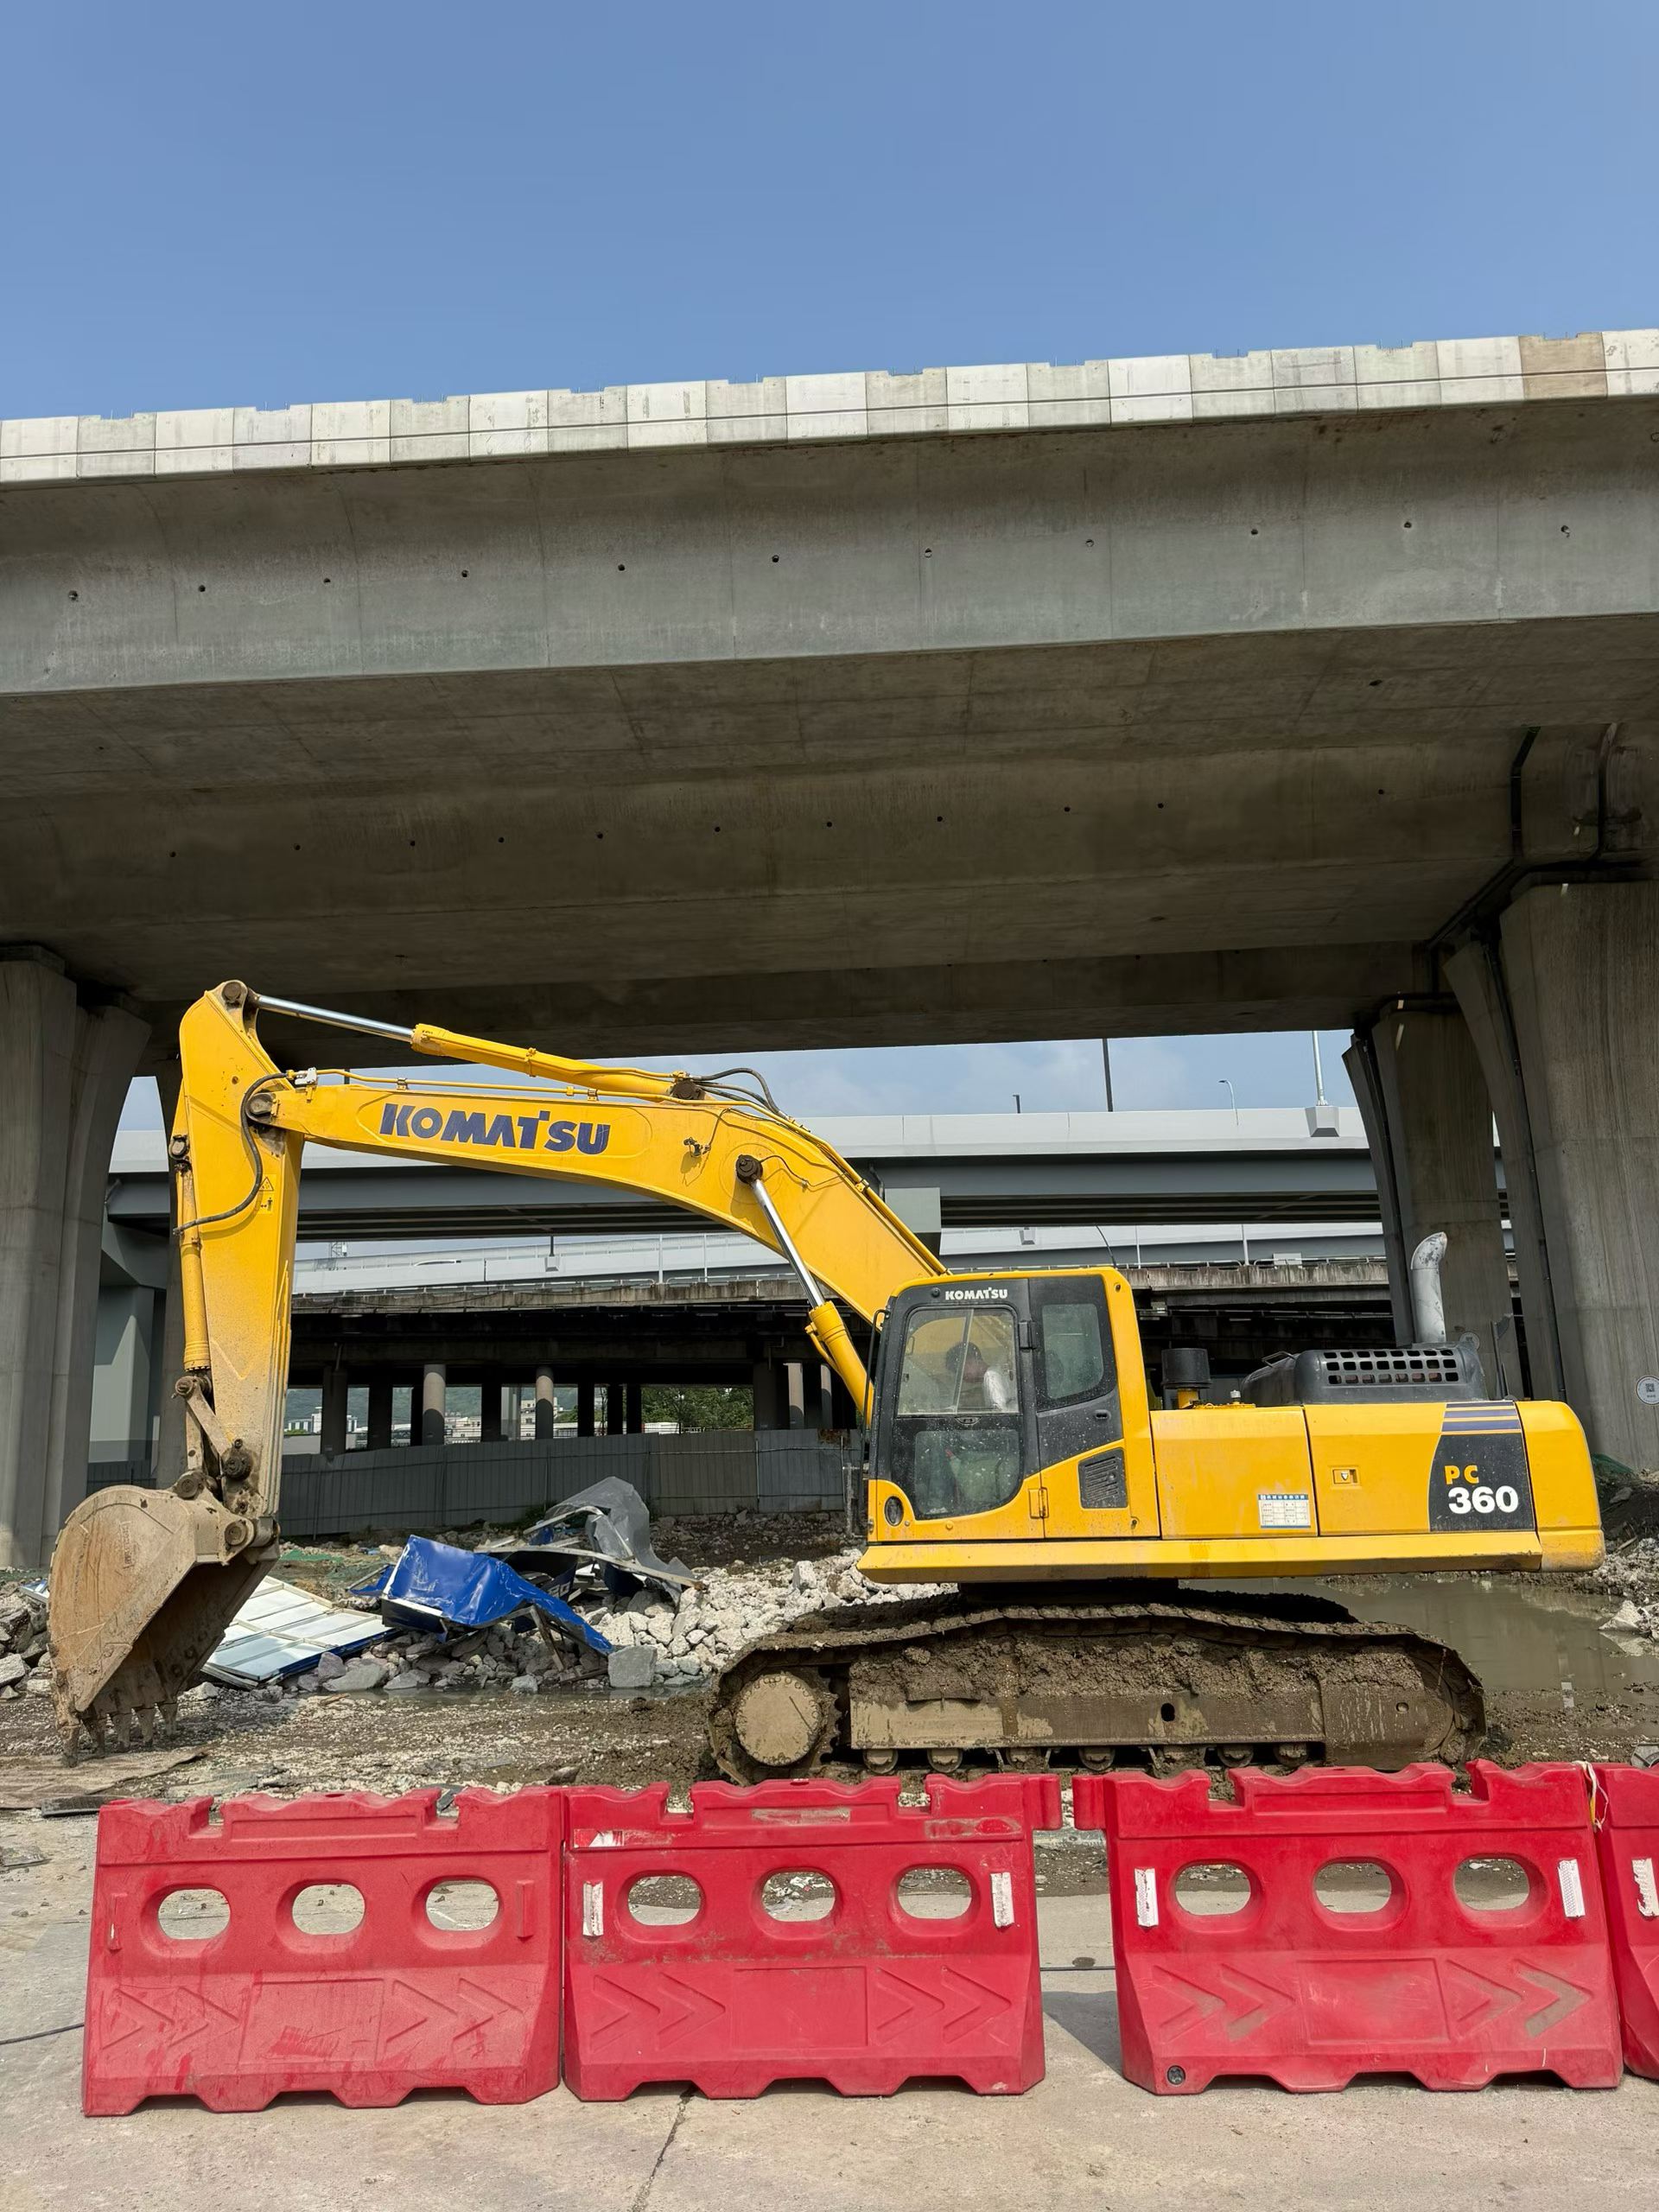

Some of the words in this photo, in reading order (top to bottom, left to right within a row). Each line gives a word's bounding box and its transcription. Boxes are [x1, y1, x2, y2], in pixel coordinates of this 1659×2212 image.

[379, 1103, 611, 1154] KOMATSU
[945, 1287, 1007, 1300] KOMATSU
[1444, 1465, 1479, 1484] PC
[1448, 1485, 1519, 1514] 360
